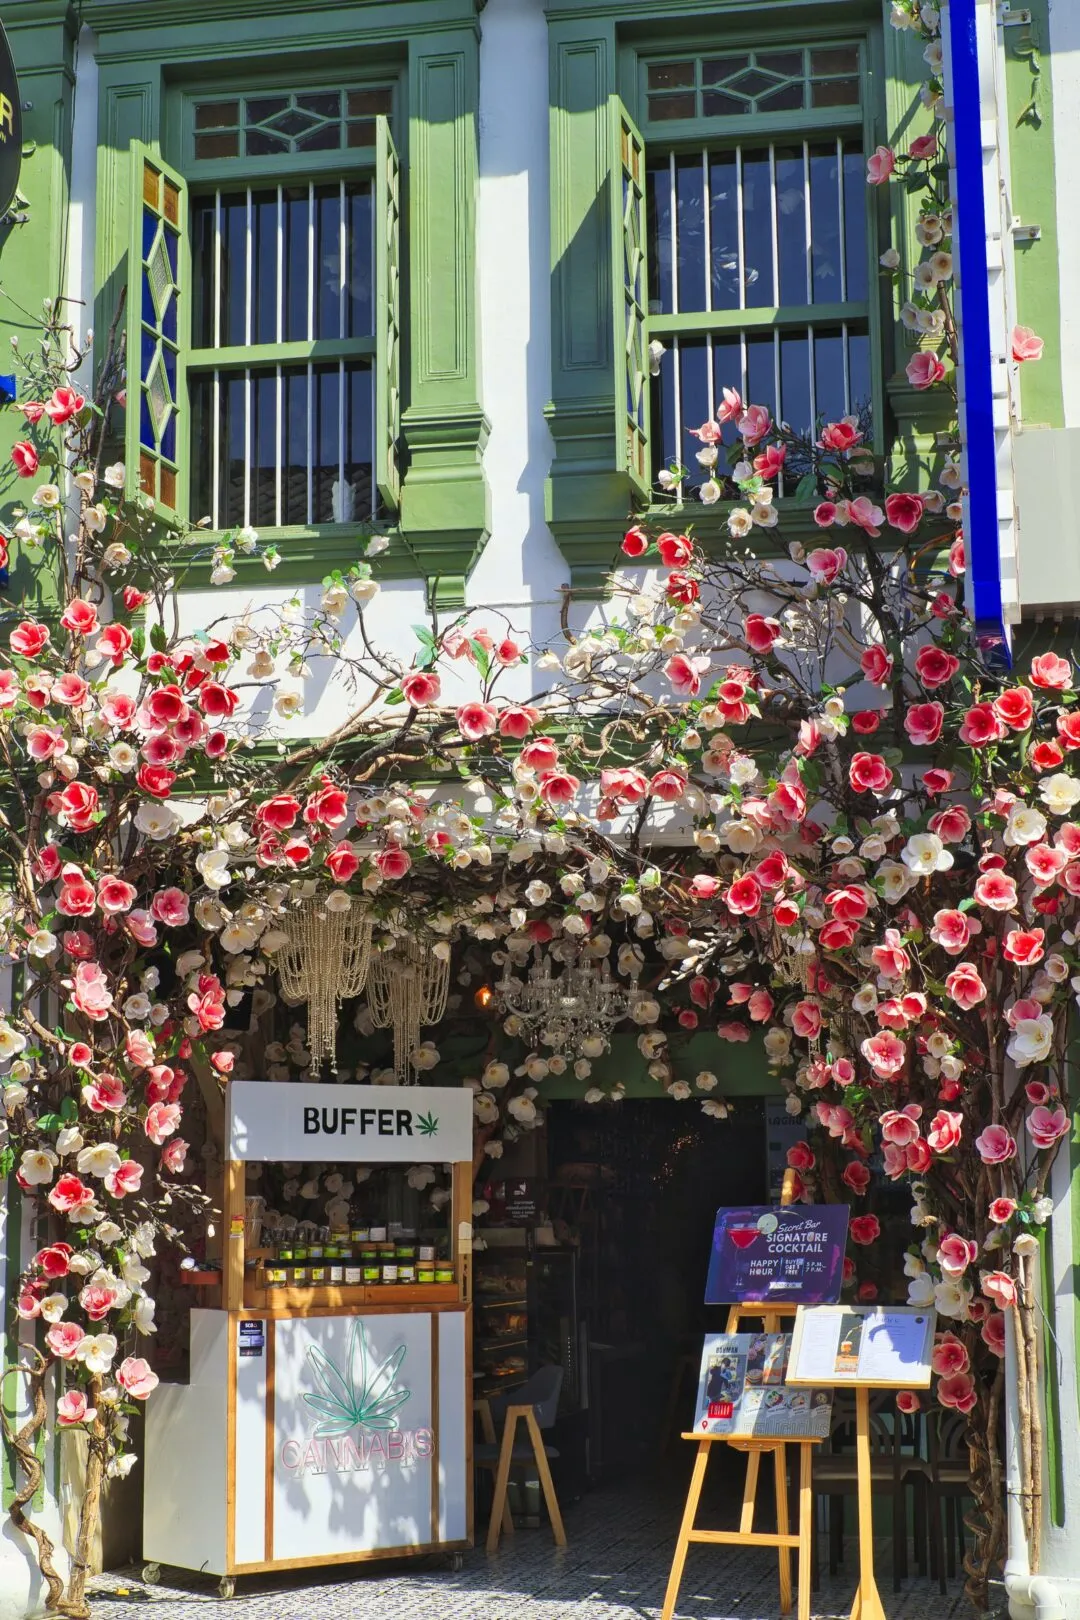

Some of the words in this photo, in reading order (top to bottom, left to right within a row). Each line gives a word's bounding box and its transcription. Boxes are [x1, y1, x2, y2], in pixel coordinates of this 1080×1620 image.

[303, 1107, 414, 1136] BUFFER
[777, 1222, 804, 1233] Secret
[804, 1219, 821, 1229] Bar
[766, 1232, 828, 1242] SIGNATURE
[768, 1244, 823, 1253] COCKTAIL
[750, 1268, 773, 1276] HOUR
[281, 1428, 434, 1469] CANNABIS
